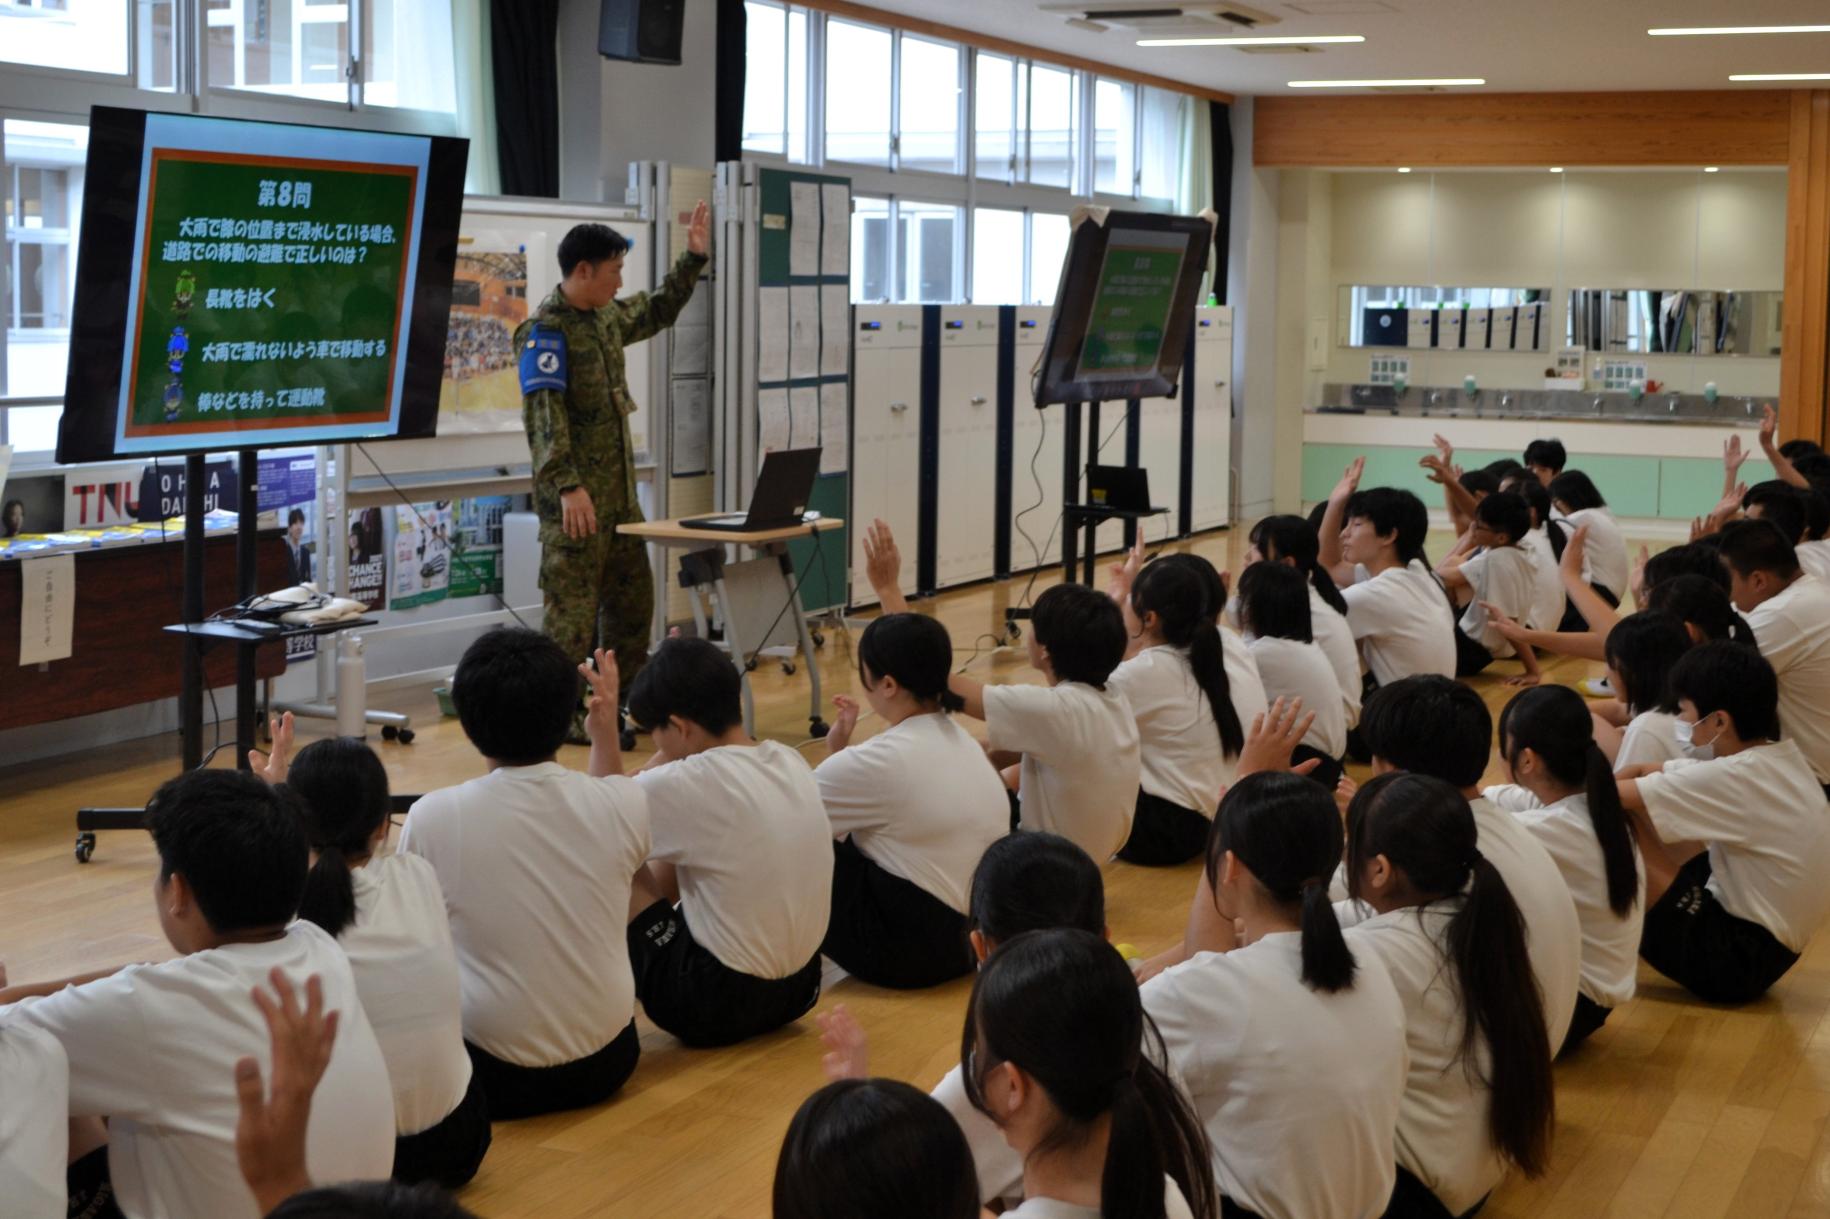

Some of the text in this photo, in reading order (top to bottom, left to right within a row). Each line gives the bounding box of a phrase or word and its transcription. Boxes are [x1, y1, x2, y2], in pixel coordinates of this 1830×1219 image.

[257, 180, 312, 208] 第8問
[205, 288, 276, 308] 長靴をはく
[202, 340, 386, 362] 大雨で濡れないよう車で移動する
